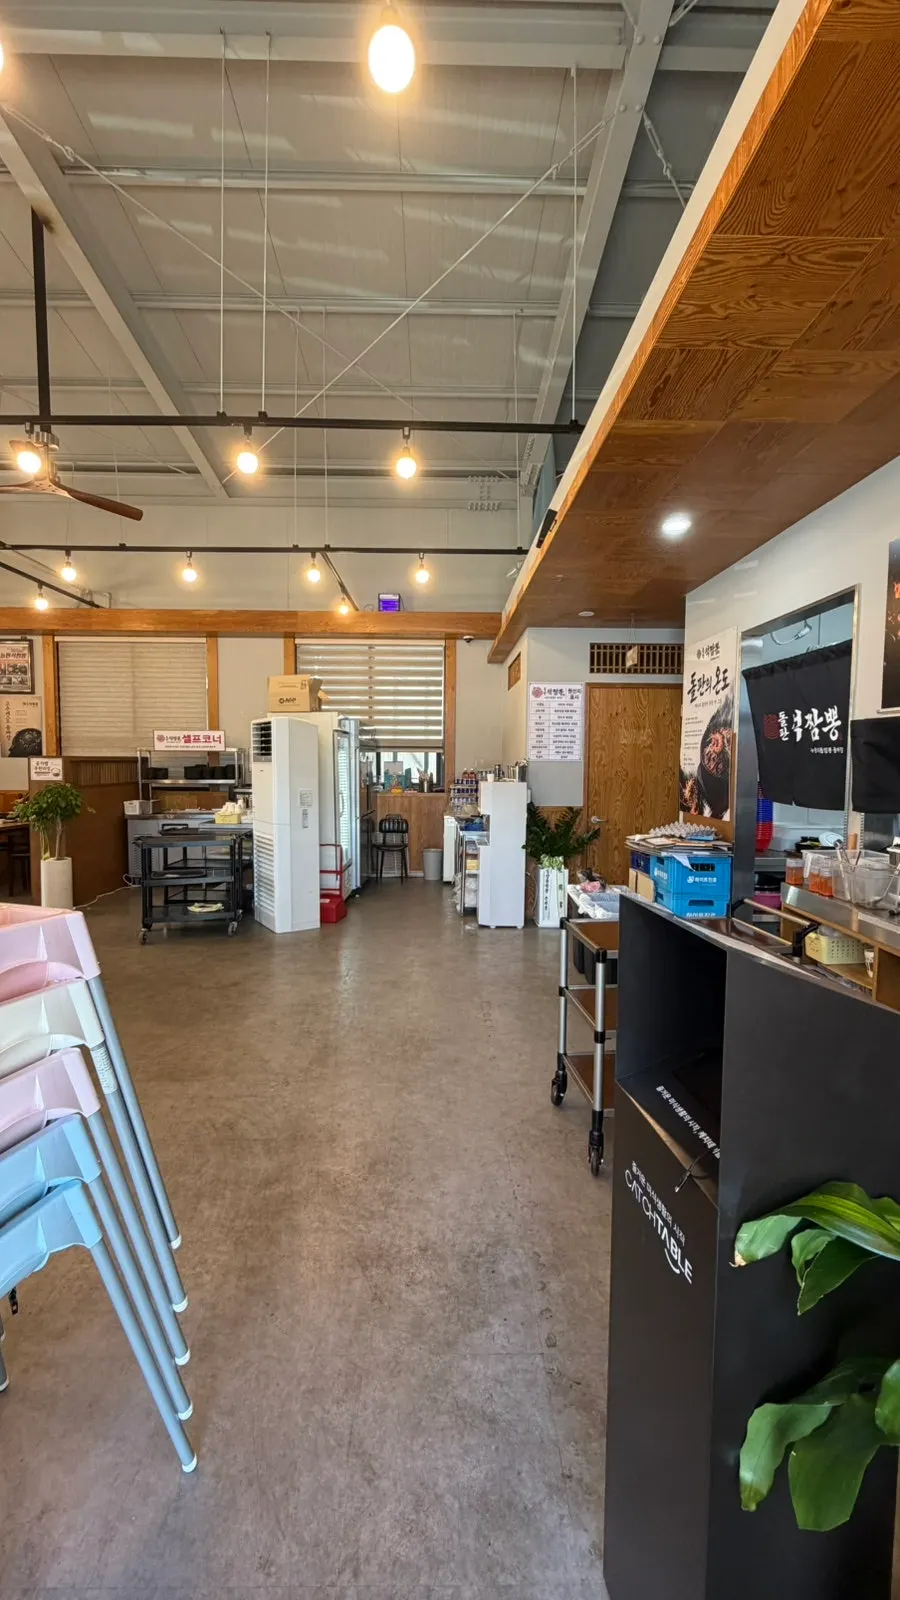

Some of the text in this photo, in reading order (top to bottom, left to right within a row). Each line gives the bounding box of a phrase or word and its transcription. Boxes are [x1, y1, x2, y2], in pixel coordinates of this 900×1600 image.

[687, 666, 730, 704] 돌판의 온도
[182, 734, 222, 744] 셀프코너
[778, 711, 789, 741] 돌판
[625, 1169, 692, 1284] CATCHTABLE
[673, 1223, 685, 1246] 시작
